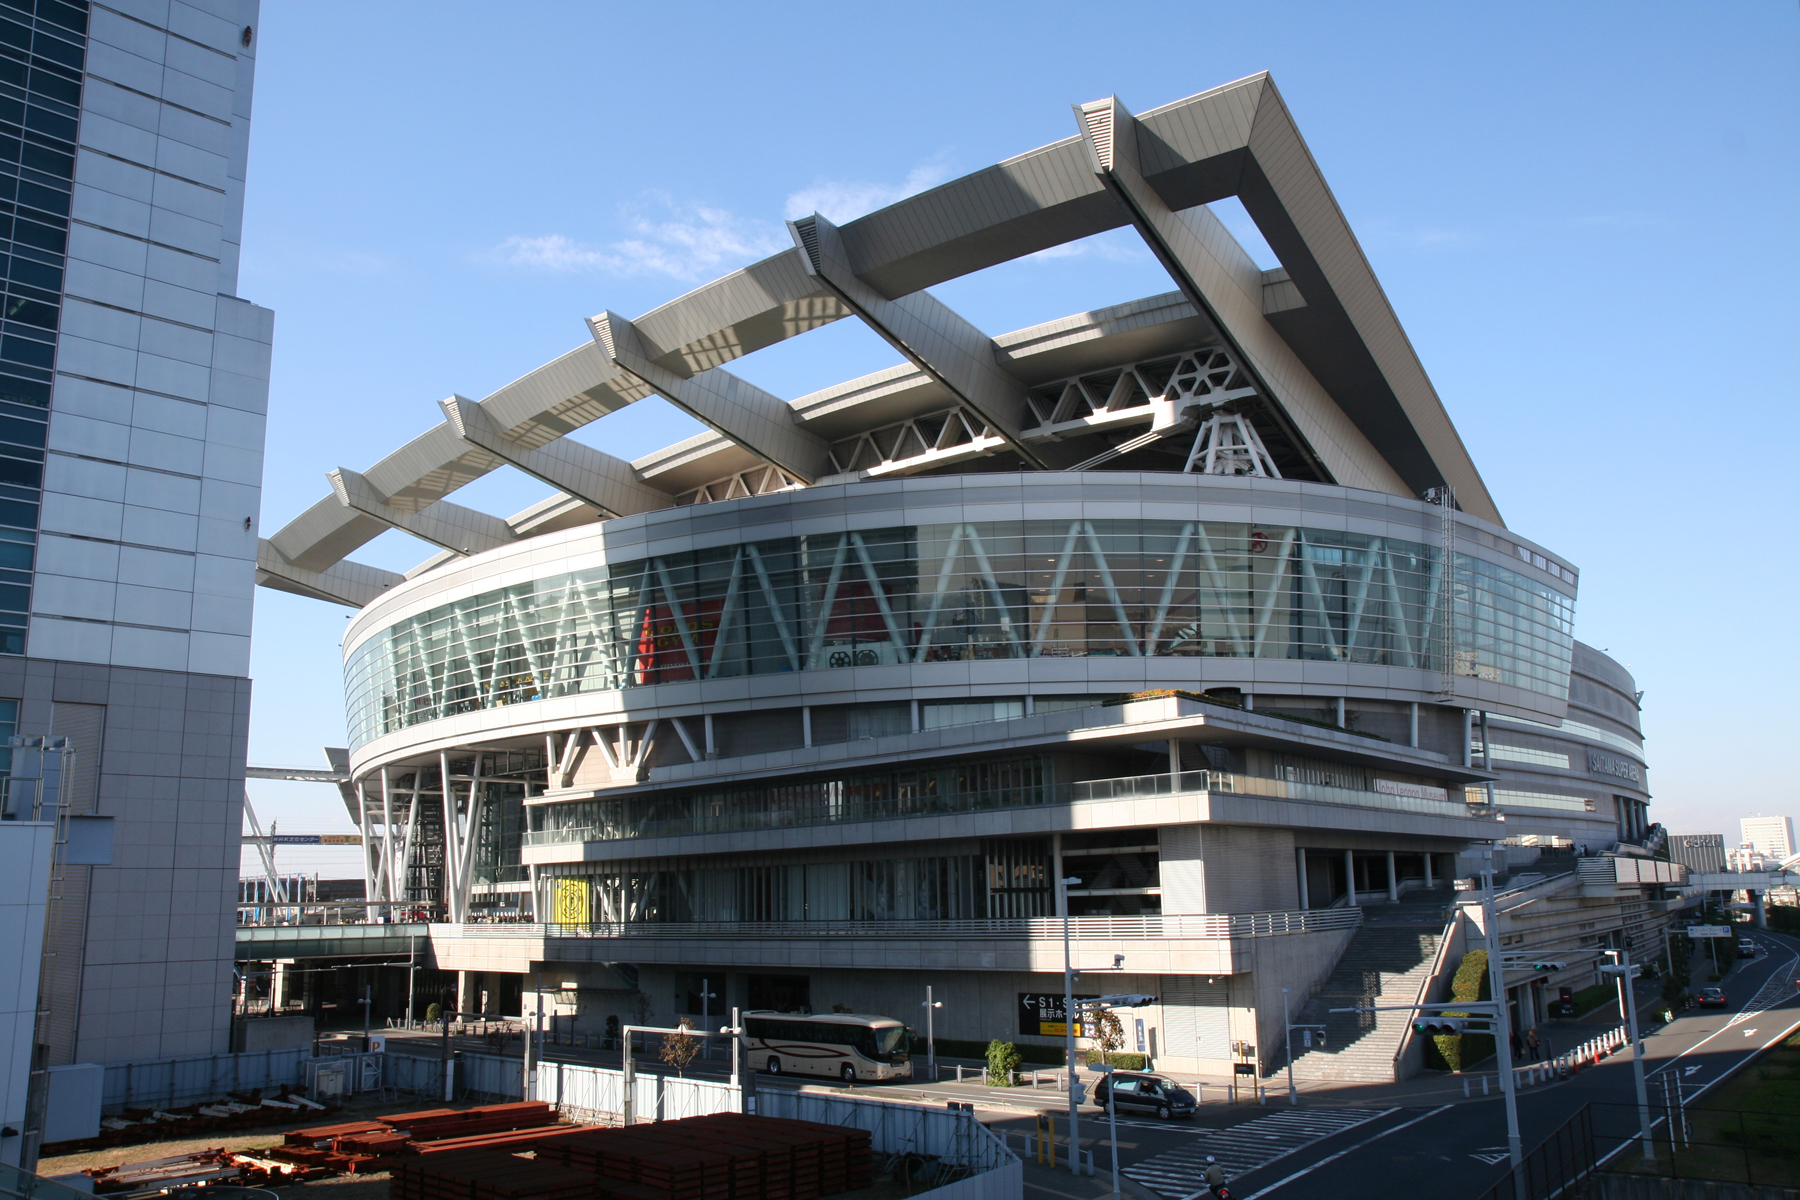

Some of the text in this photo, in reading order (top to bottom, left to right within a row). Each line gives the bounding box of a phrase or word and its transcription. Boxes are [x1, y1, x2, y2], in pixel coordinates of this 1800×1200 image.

[1377, 780, 1446, 800] John Lennon Museum
[372, 1041, 381, 1052] P
